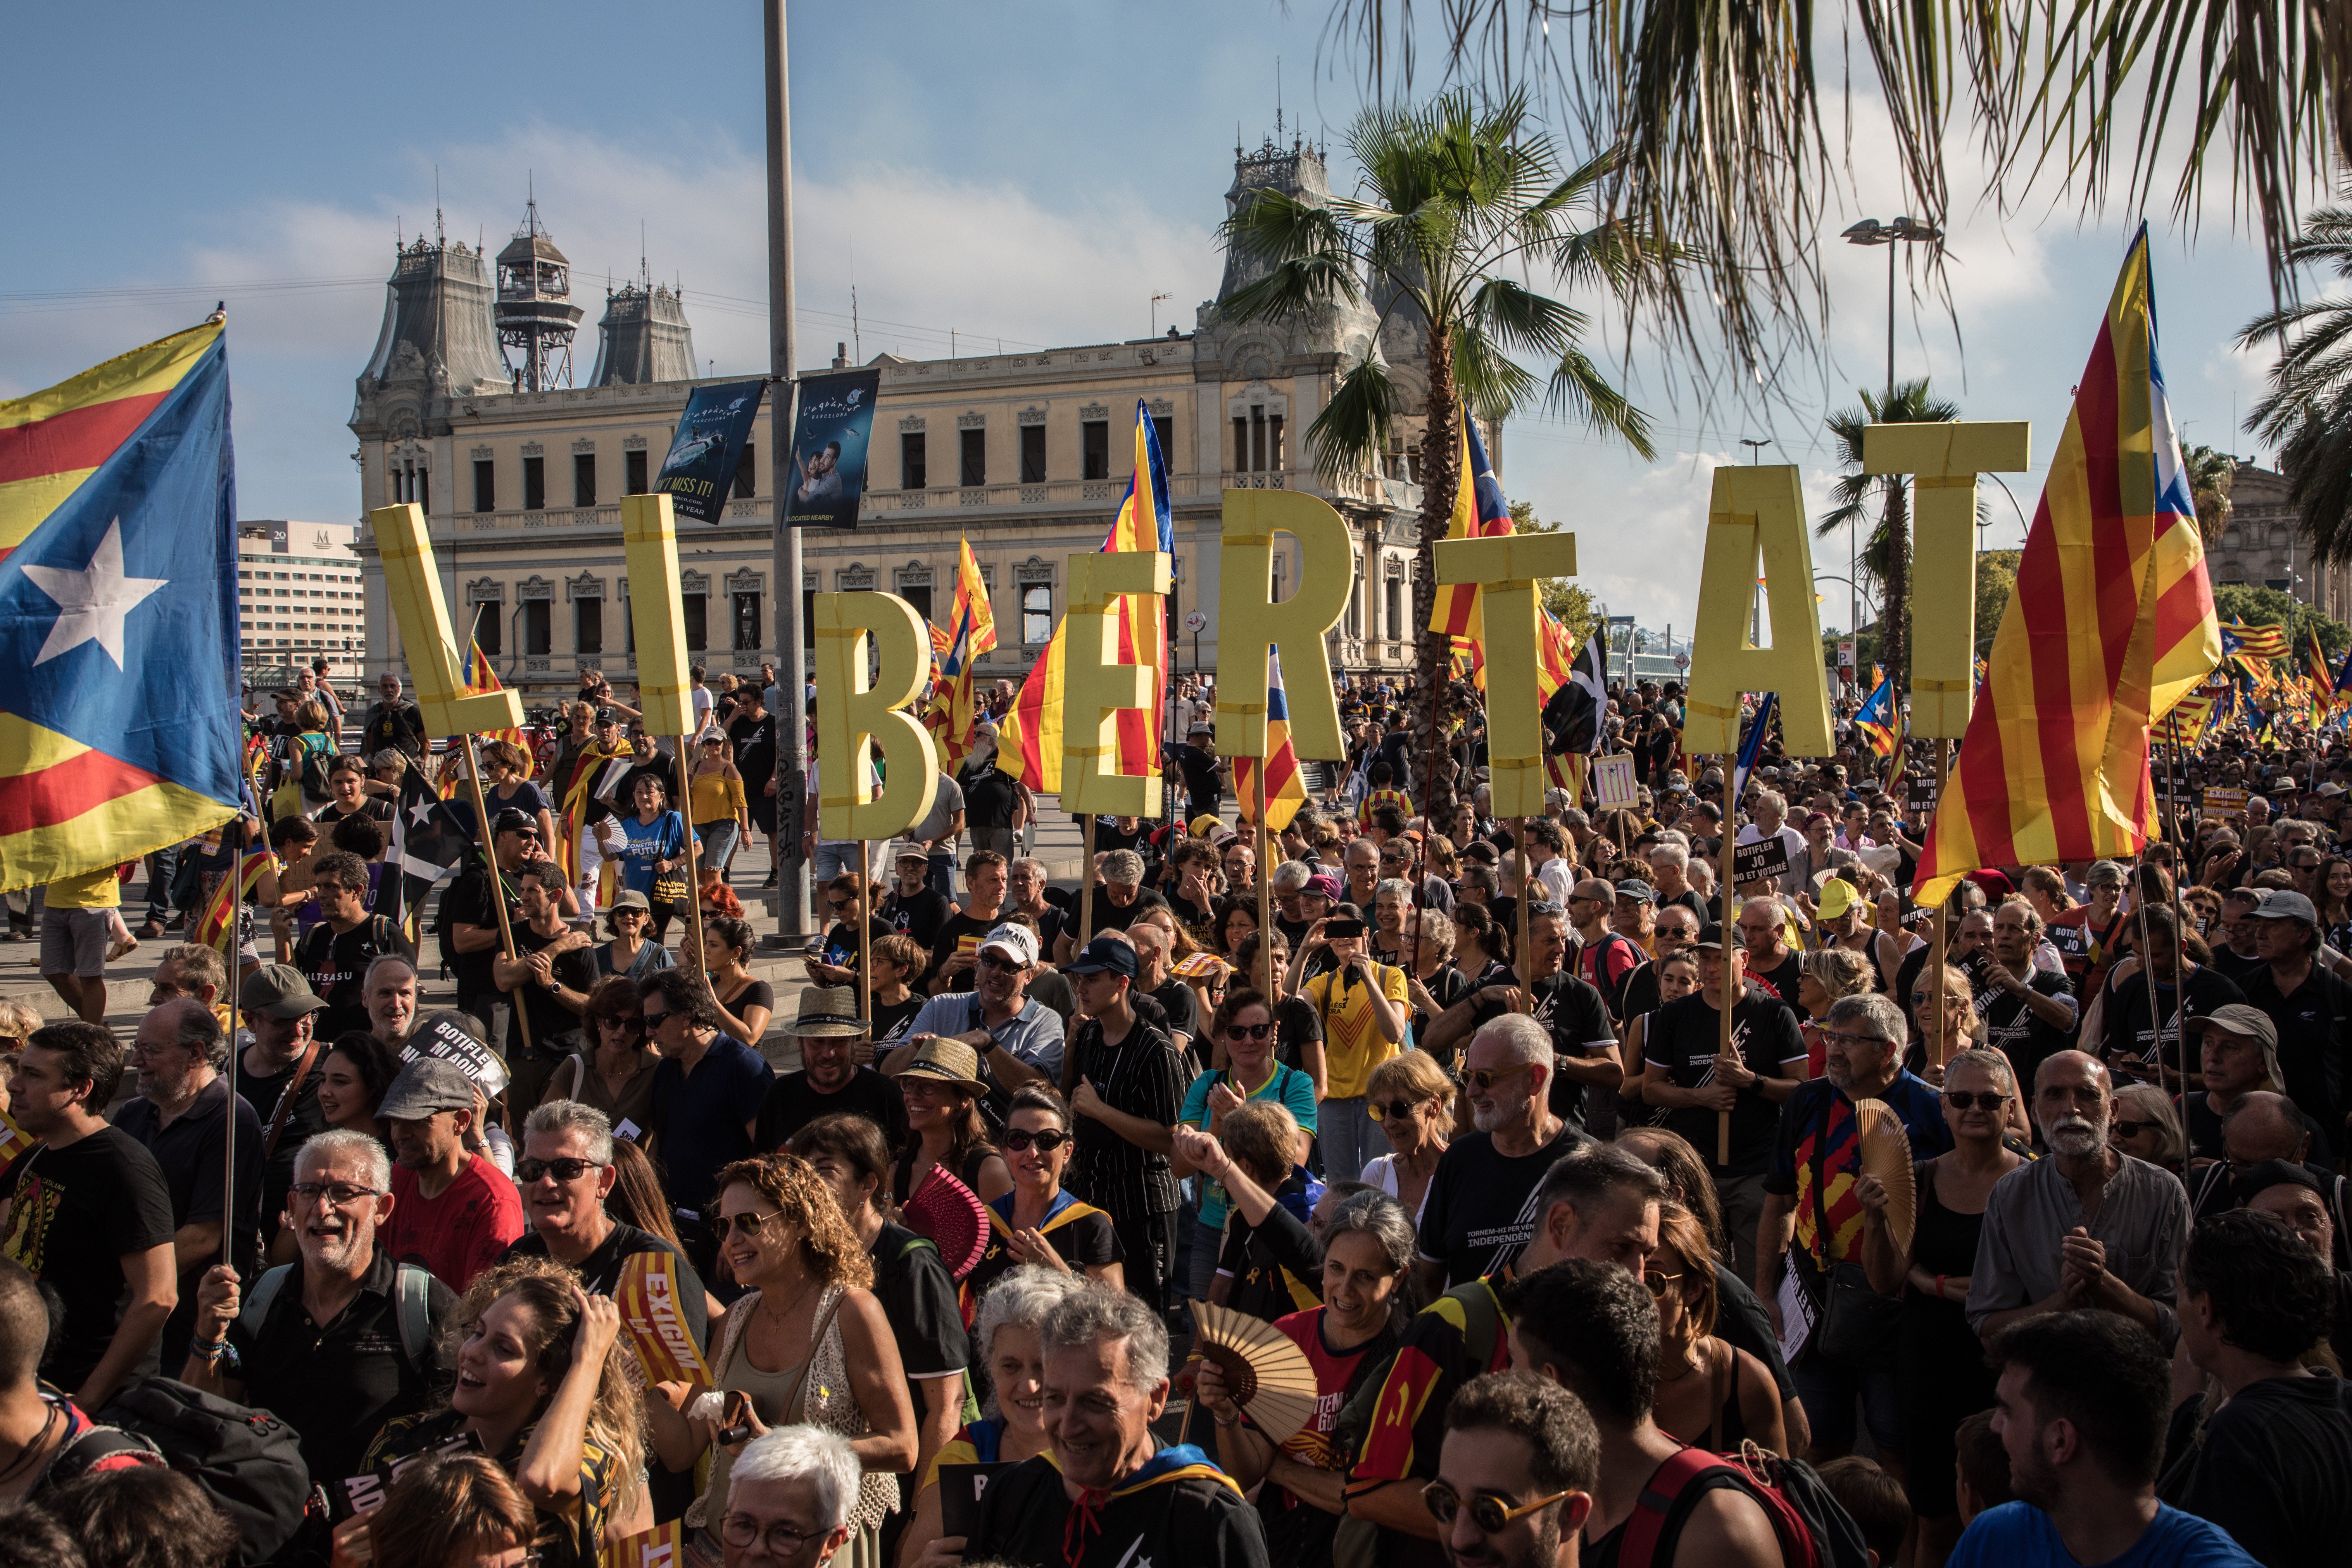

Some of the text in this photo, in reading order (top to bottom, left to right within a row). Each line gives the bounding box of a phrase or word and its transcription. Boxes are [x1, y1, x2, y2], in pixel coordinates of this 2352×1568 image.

[670, 478, 697, 493] MISS
[697, 481, 714, 498] IT!
[673, 495, 702, 506] mbcn.com
[685, 505, 705, 516] YEAR
[1917, 779, 1936, 787] BOTIF
[2160, 777, 2185, 785] BOLER
[2174, 794, 2192, 802] OTARÉ
[2209, 790, 2242, 800] EXIGIM
[1370, 799, 1399, 807] CATALUNYA
[1910, 801, 1920, 810] NO
[1922, 801, 1931, 809] ET
[1737, 841, 1774, 858] BOTIFLER
[1751, 855, 1765, 868] JO
[1733, 860, 1787, 882] NO ET VOTARÉ
[1901, 915, 1908, 924] NO
[1909, 911, 1916, 921] ET
[2055, 927, 2078, 938] BOTIF
[2064, 938, 2079, 951] JO
[305, 971, 352, 982] ALTSASU
[399, 1045, 421, 1063] NI
[429, 1041, 452, 1058] NI
[981, 1100, 1005, 1126] Champ
[1467, 1225, 1507, 1238] TORNEM-HI
[1468, 1231, 1531, 1247] INDEPENDÈN
[1798, 1289, 1808, 1310] ET
[646, 1272, 701, 1370] EXIGIM
[1805, 1304, 1815, 1328] NO
[628, 1318, 653, 1334] LA
[1313, 1392, 1344, 1414] ITEM
